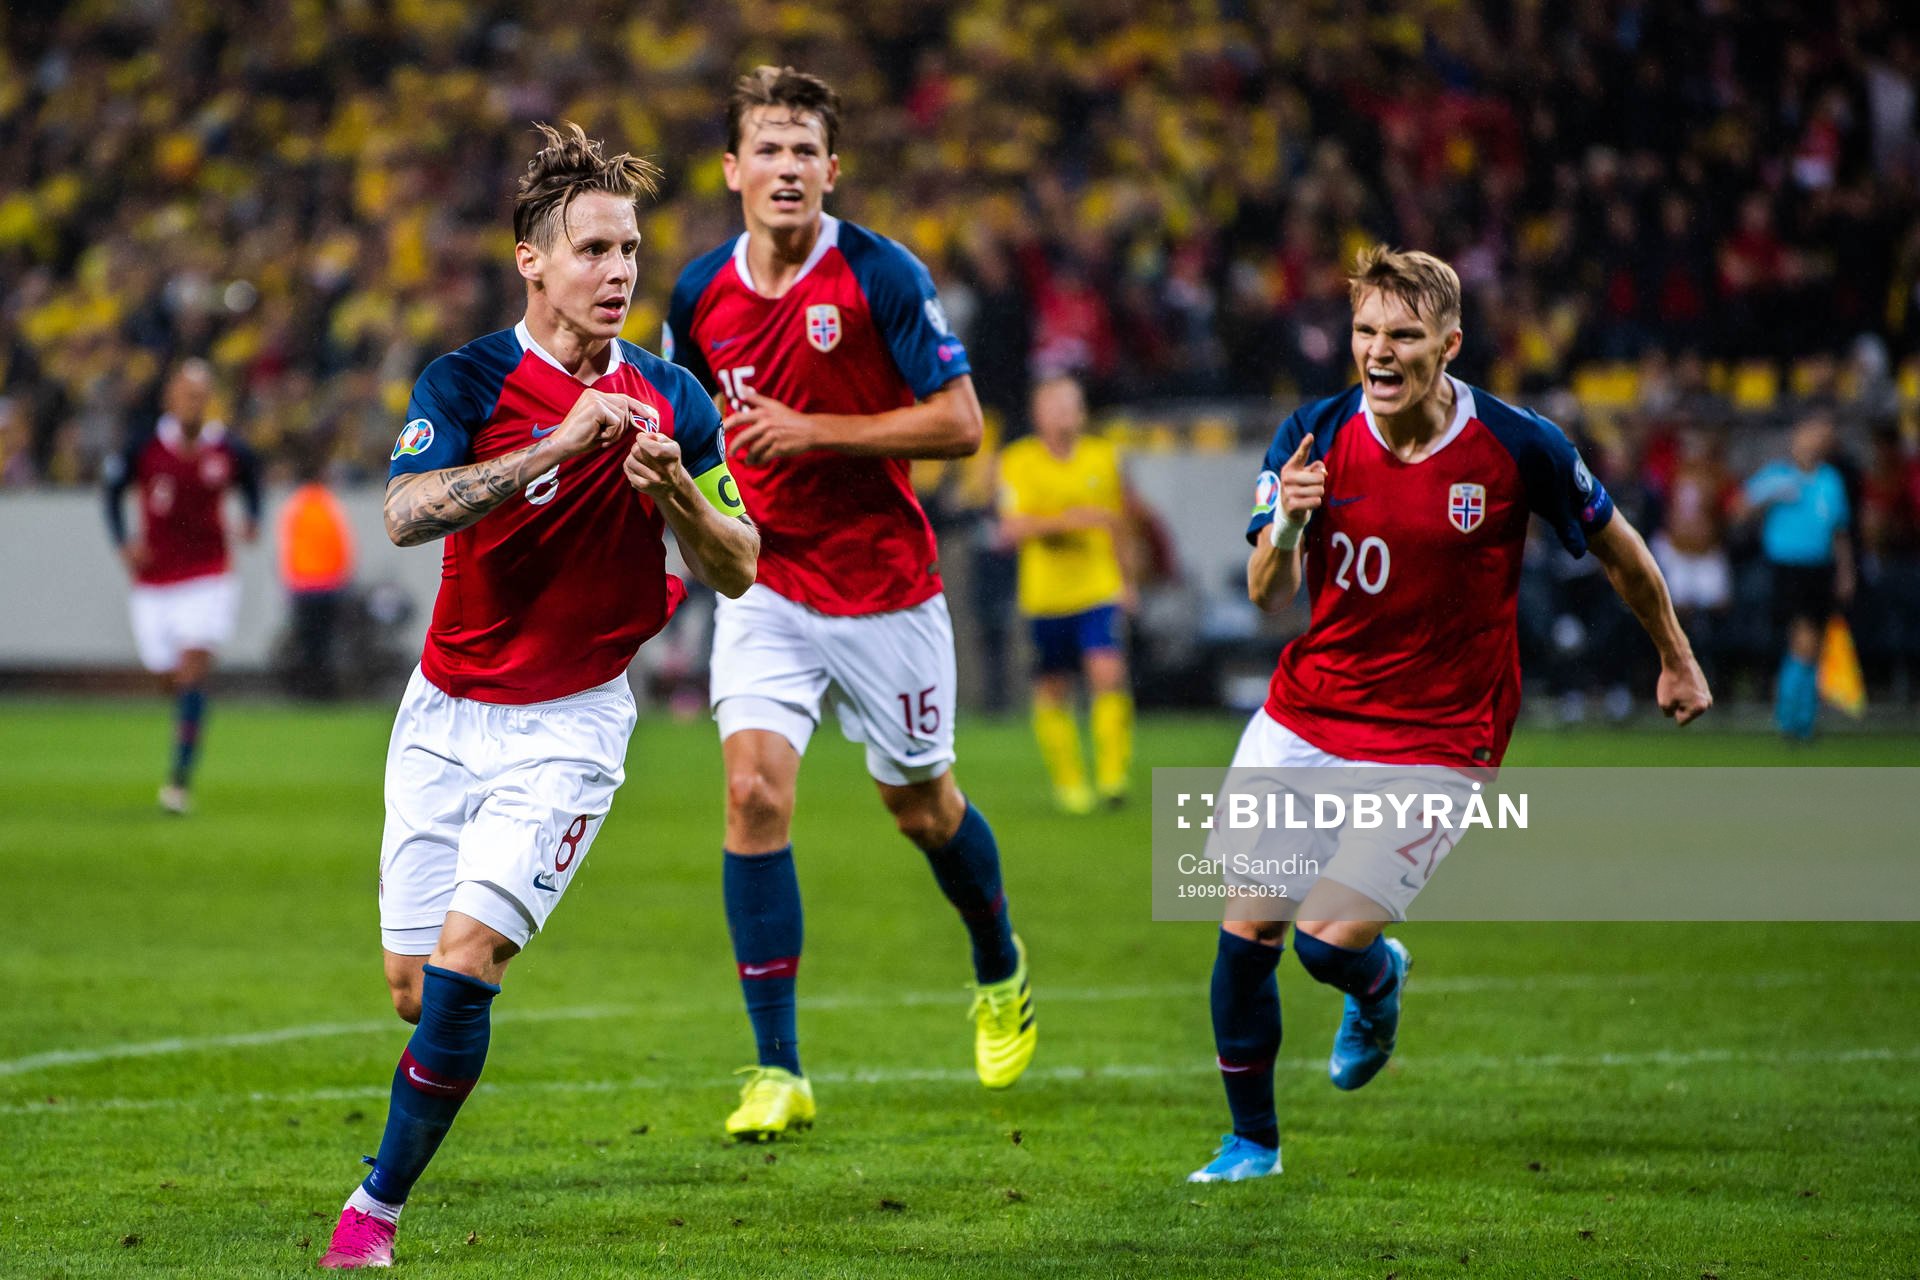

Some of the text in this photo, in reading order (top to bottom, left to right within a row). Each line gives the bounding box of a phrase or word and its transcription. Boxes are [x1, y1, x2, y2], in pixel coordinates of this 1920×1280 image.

[718, 475, 740, 507] C
[1332, 532, 1390, 594] 20
[898, 684, 940, 737] 15
[555, 814, 587, 872] 8
